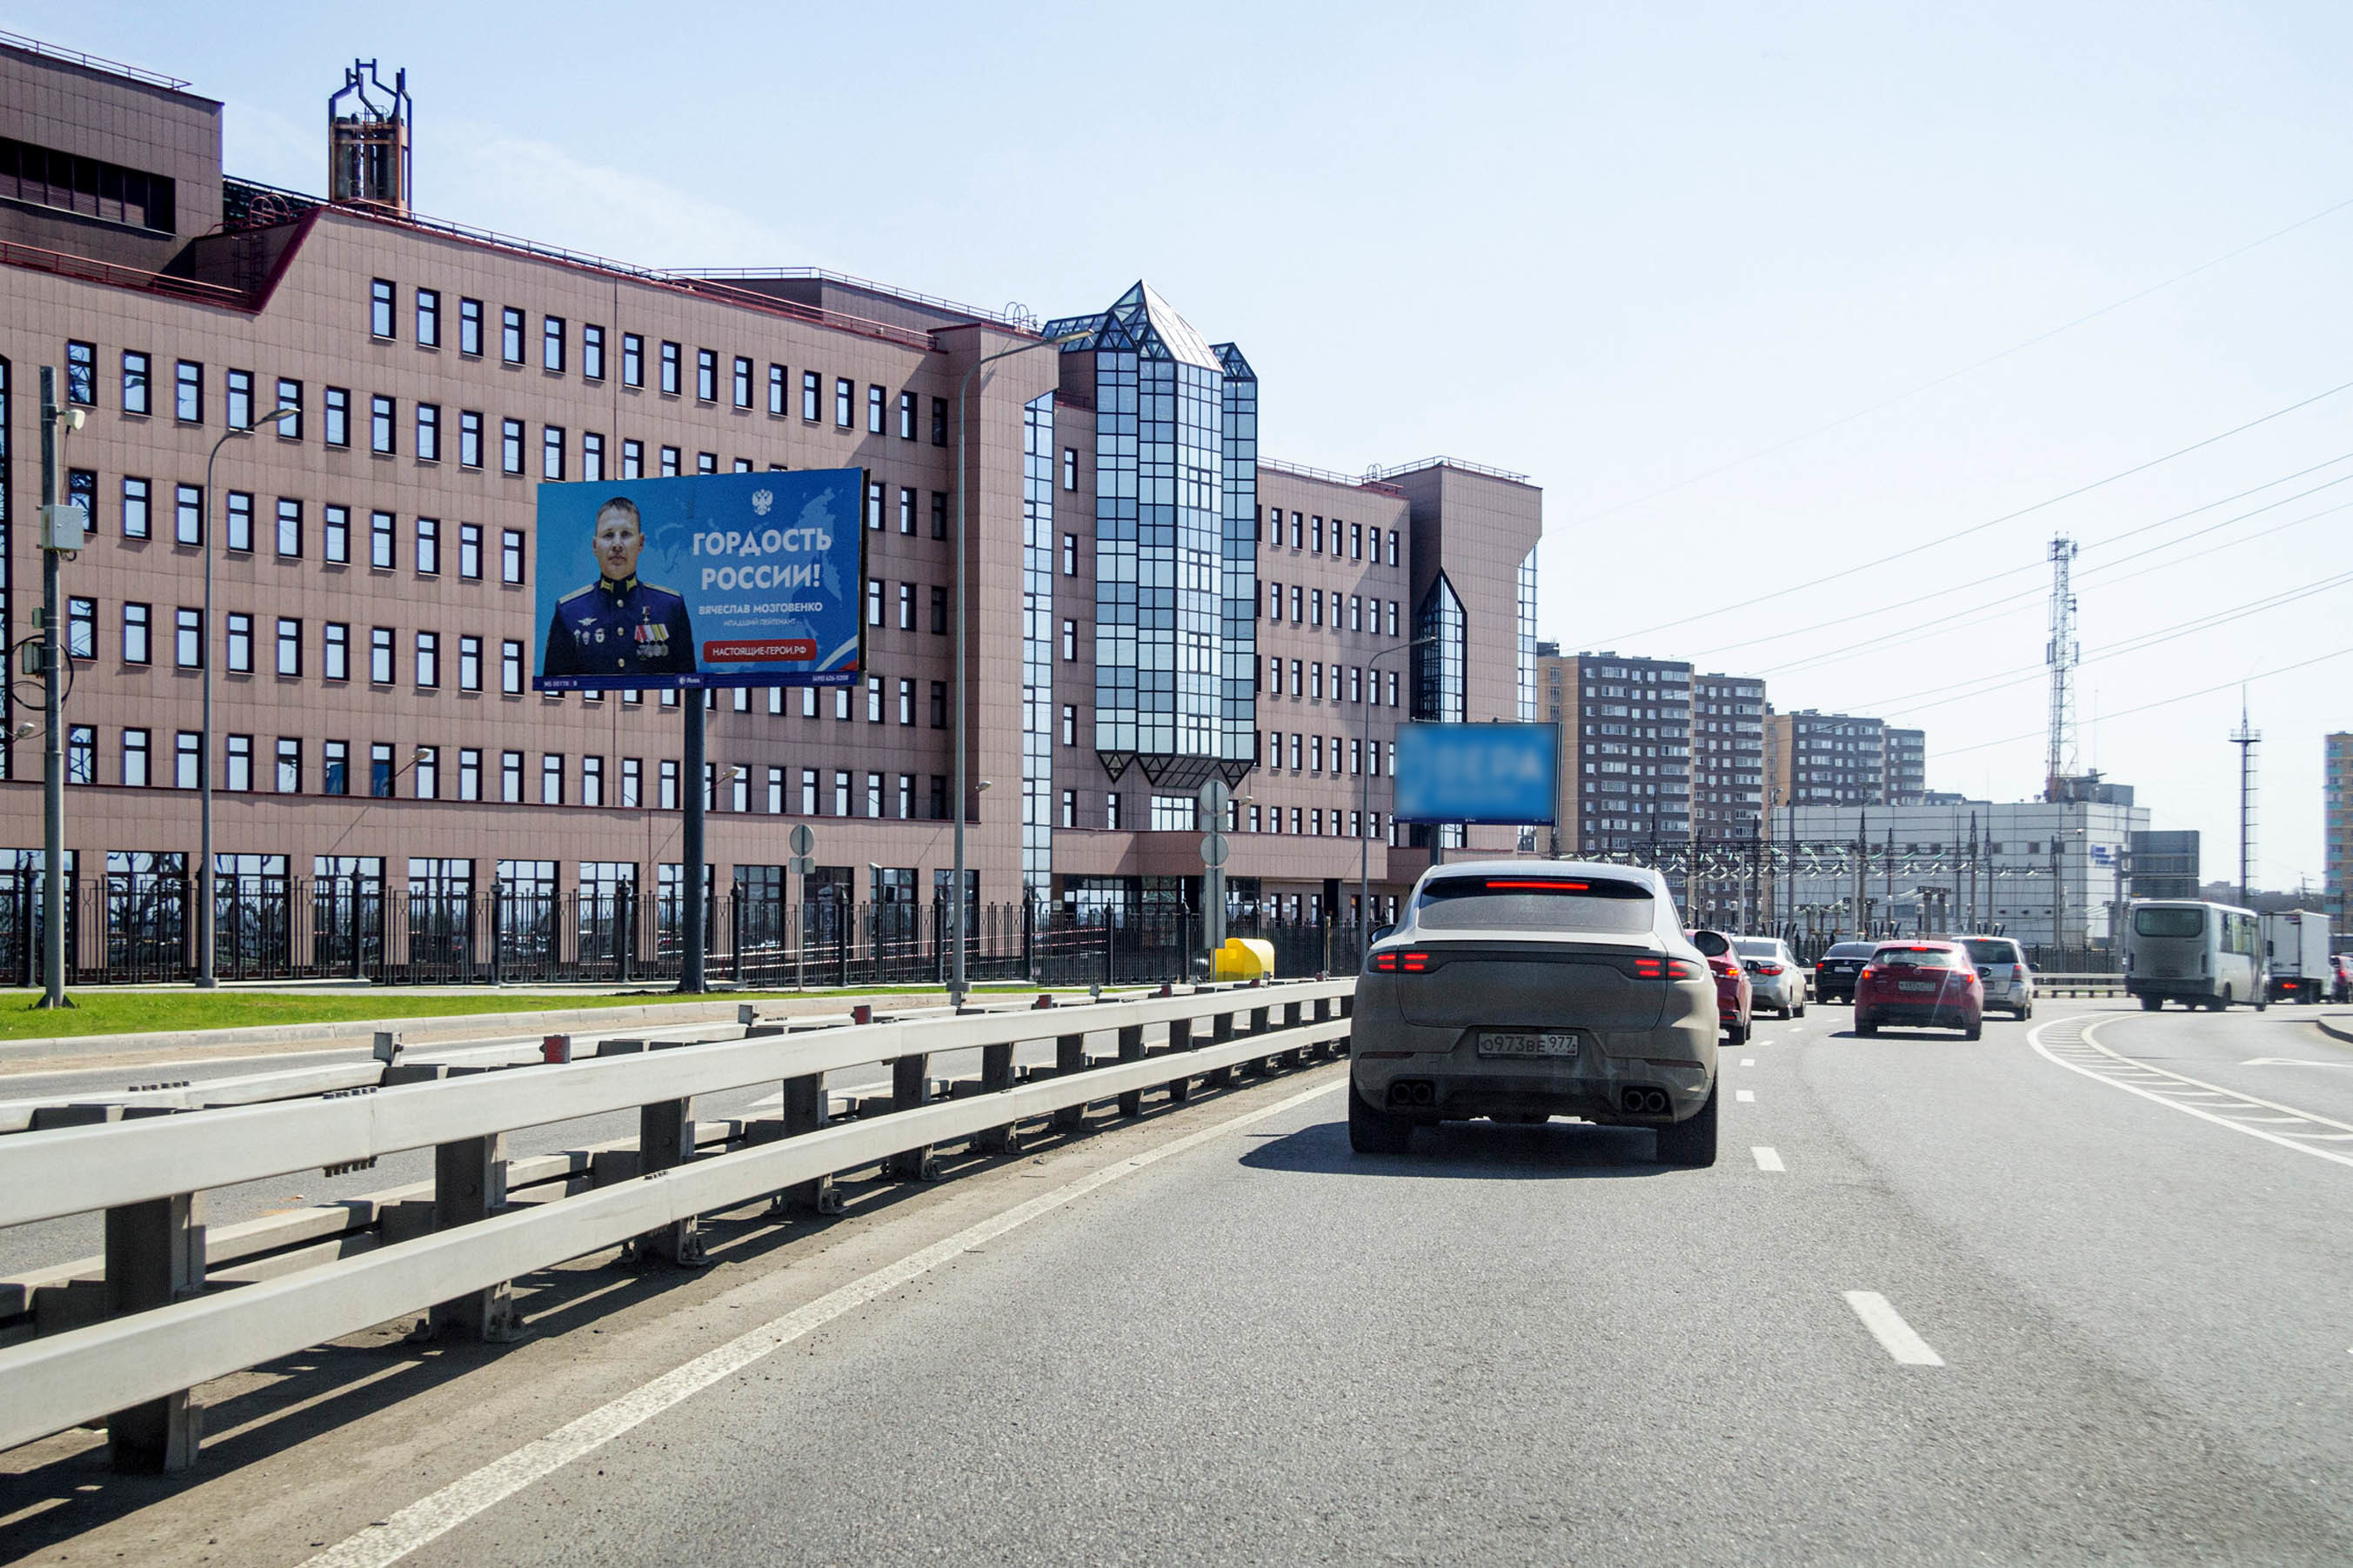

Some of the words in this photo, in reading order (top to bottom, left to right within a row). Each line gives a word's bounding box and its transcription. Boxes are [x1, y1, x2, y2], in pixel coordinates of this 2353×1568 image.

[693, 528, 832, 557] ГОРДОСТЬ
[702, 564, 820, 591] РОССИИ!
[699, 604, 750, 615] ВЯЧЕСЛАВ
[753, 602, 823, 613] МОЗГОВЕНКО
[712, 645, 806, 656] НАСТОЯЩИЕ-ГЕРОИ.РФ
[1483, 1036, 1546, 1052] О973ВЕ
[1549, 1036, 1574, 1049] 977
